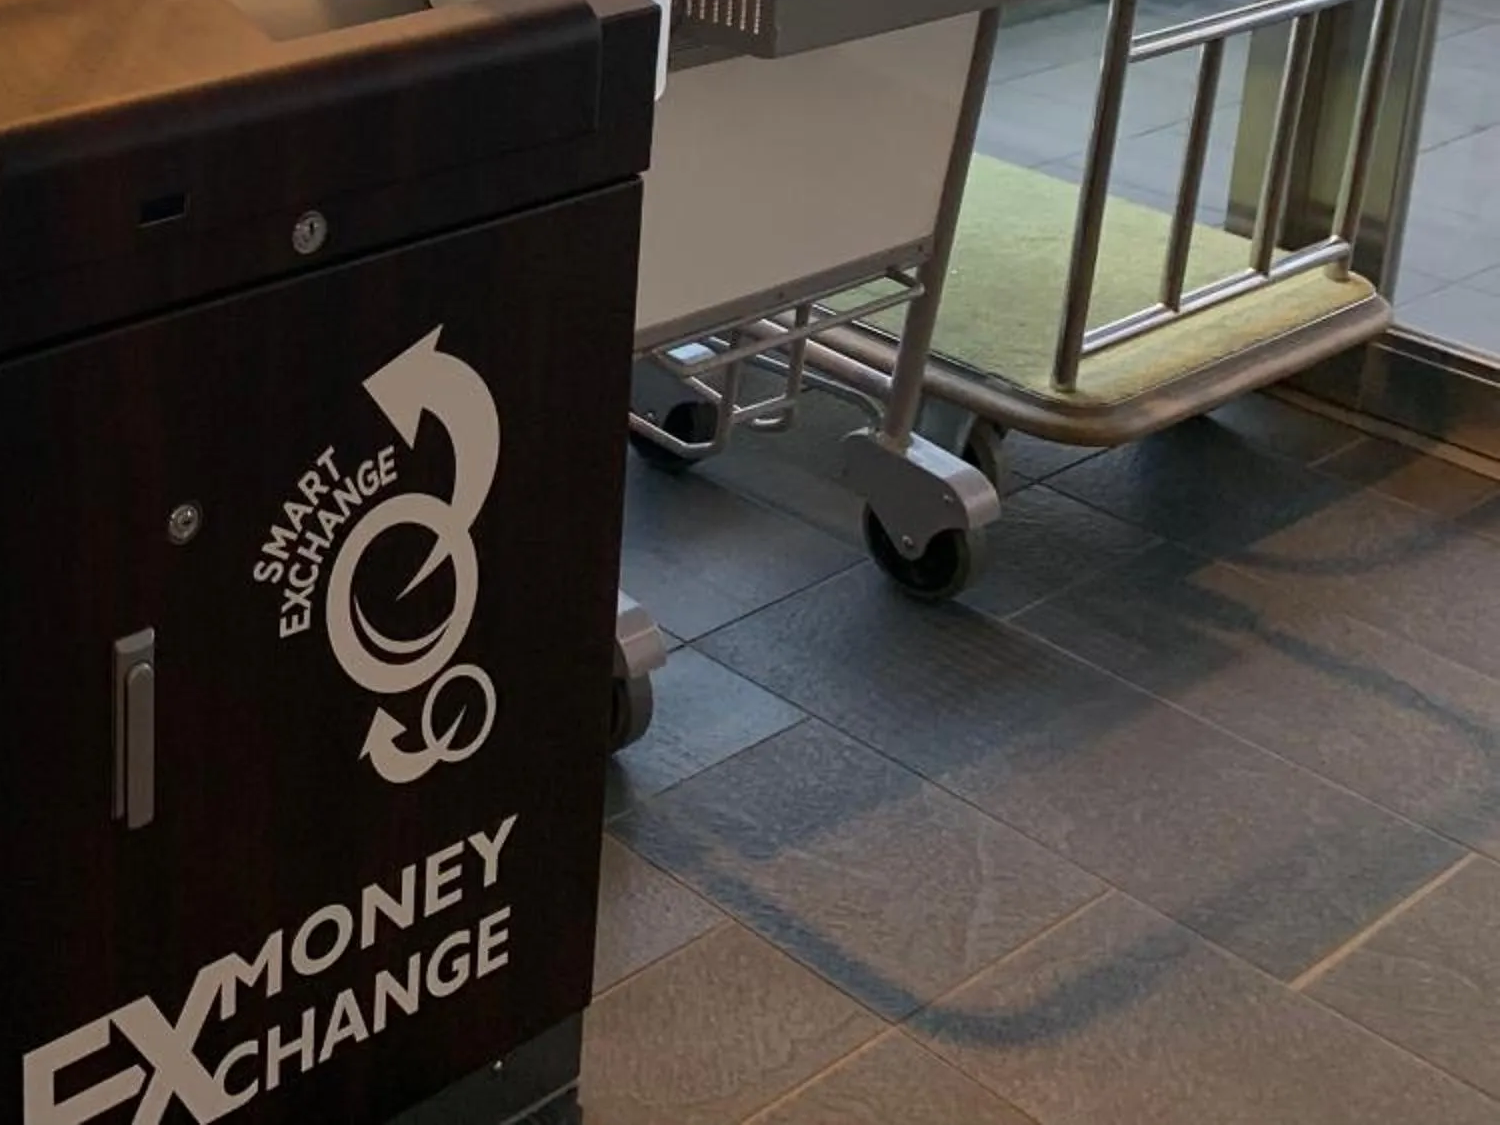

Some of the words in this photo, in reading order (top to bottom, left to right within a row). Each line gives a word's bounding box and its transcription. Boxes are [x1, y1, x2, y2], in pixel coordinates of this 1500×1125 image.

[253, 445, 341, 584] SMART
[279, 445, 399, 639] EXCHANGE
[219, 814, 518, 1021] MONEY
